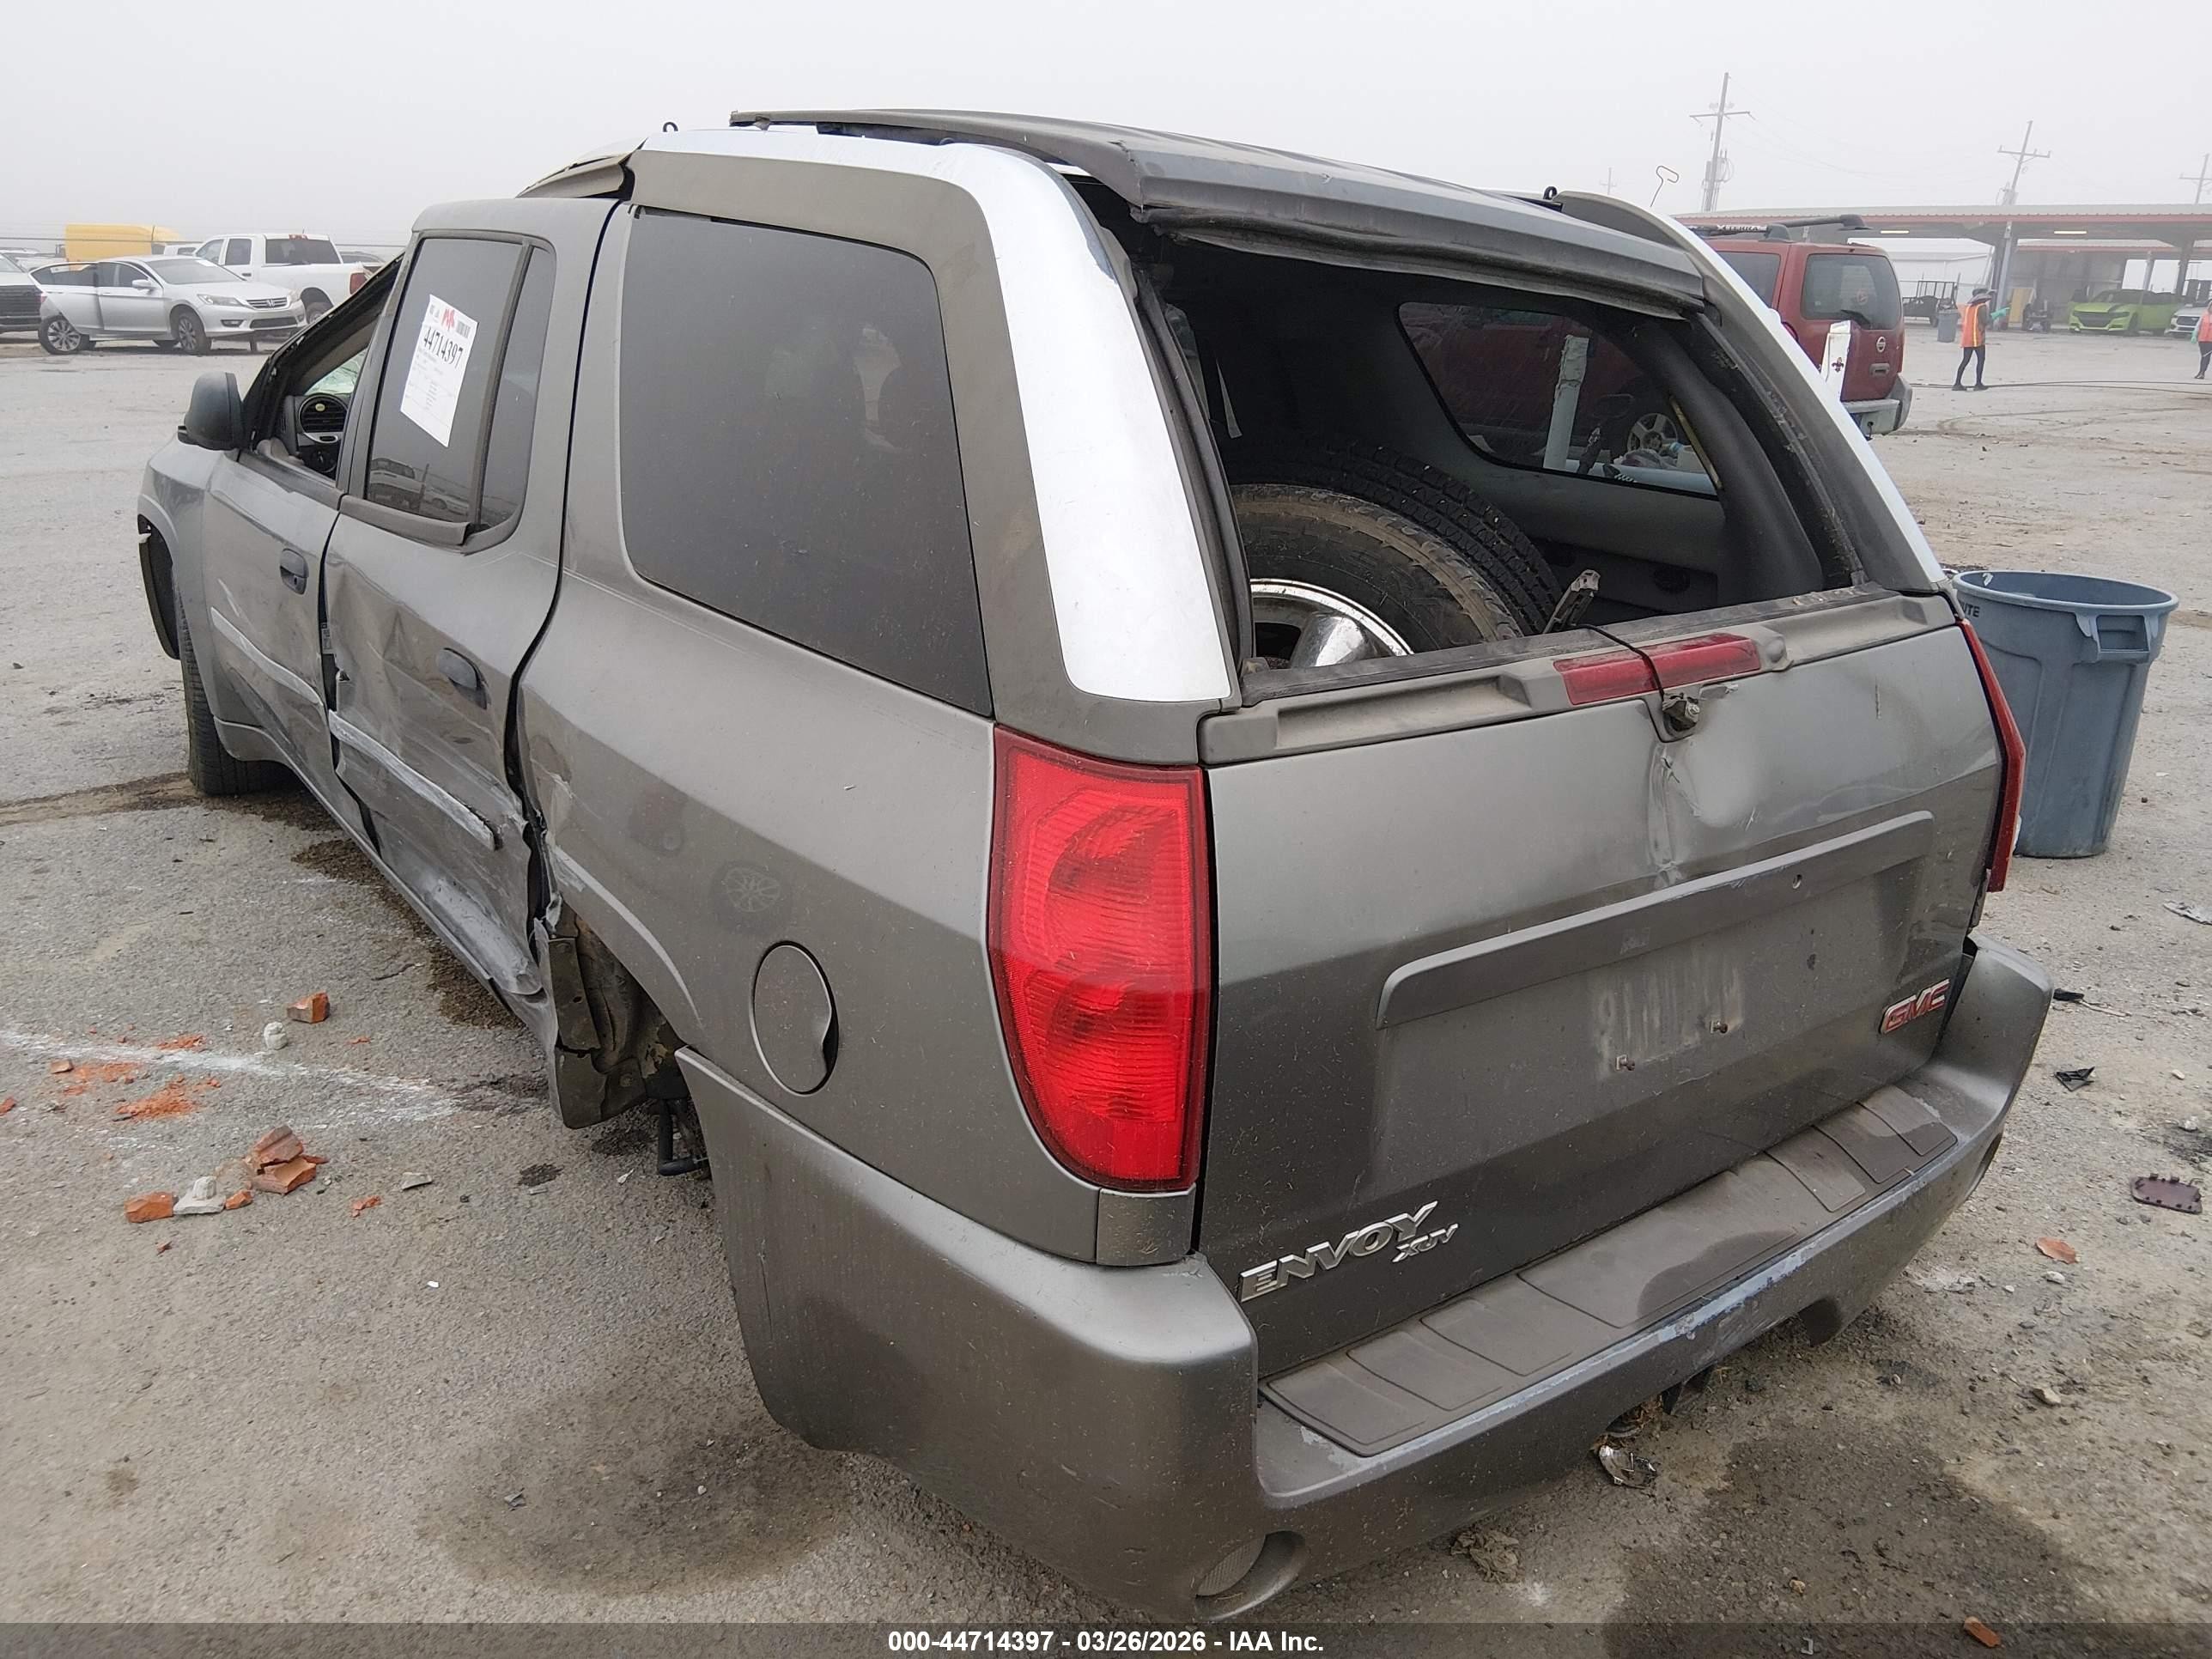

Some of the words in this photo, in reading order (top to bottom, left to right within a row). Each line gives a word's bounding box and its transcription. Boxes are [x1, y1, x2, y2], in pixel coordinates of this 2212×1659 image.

[423, 326, 464, 369] 44714397
[1881, 978, 1951, 1035] GMC
[1240, 1200, 1438, 1303] ENVOY
[1392, 1223, 1459, 1263] XUV
